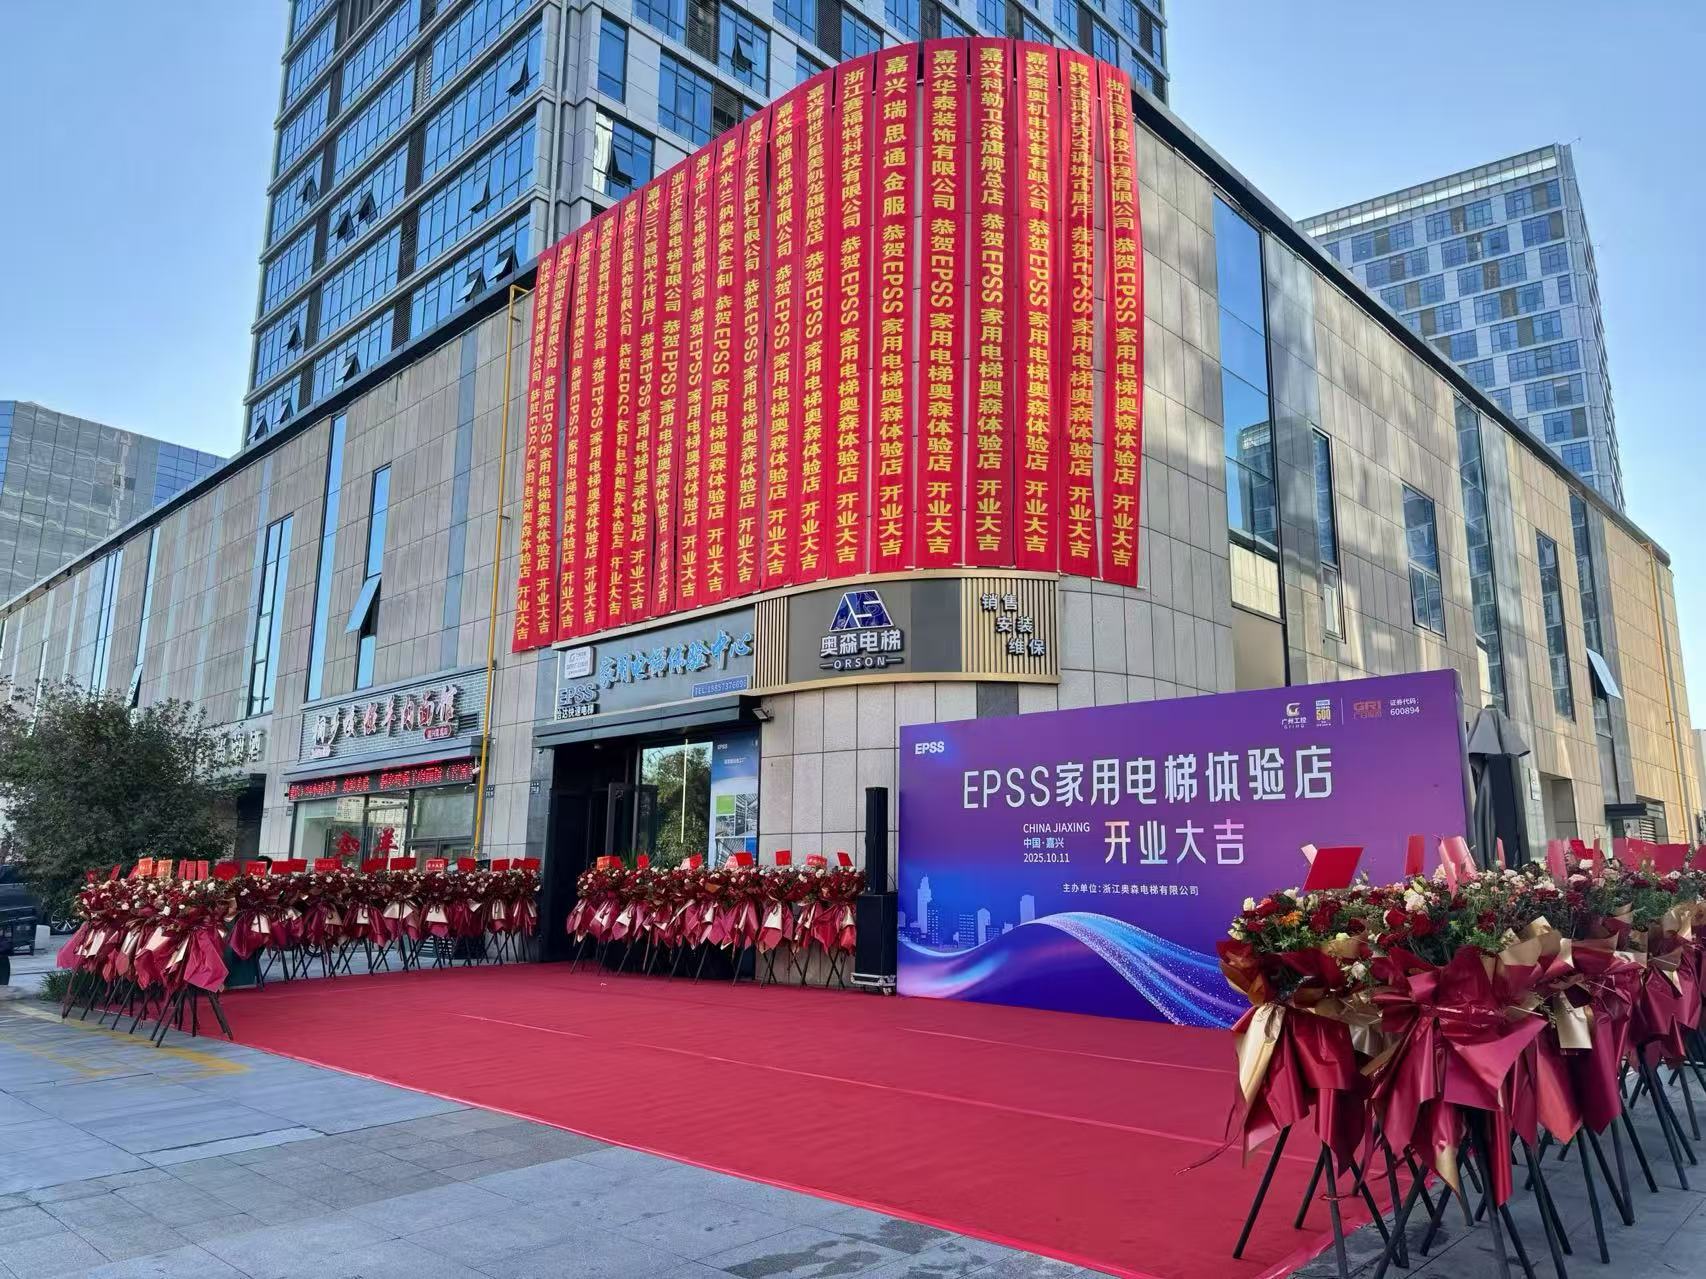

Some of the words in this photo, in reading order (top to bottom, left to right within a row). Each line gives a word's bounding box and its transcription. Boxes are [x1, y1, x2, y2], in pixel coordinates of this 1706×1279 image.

[841, 69, 864, 228] 浙江赛福特科技有限公司
[883, 56, 907, 216] 嘉兴瑞思通金服
[931, 49, 956, 211] 嘉兴华泰装饰有限公司
[980, 47, 1005, 205] 嘉兴科勒卫浴旗舰总店
[776, 101, 793, 257] 嘉兴畅通电梯有限公司
[692, 154, 709, 299] 海宁市广达电梯有限公司
[716, 139, 735, 287] 嘉兴米兰纳整家定制
[642, 186, 660, 328] 嘉兴三只喜鹊木作展厅
[767, 508, 786, 576] 开业大吉
[800, 501, 818, 570] 开业大吉
[837, 492, 857, 564] 开业大吉
[880, 485, 902, 556] 开业大吉
[927, 481, 952, 554] 开业大吉
[976, 479, 1000, 551] 开业大吉
[1025, 480, 1046, 553] 开业大吉
[1070, 486, 1090, 558] 开业大吉
[1113, 494, 1133, 566] 开业大吉
[631, 549, 644, 609] 开业大吉
[657, 542, 670, 604] 开业大吉
[681, 534, 697, 597] 开业大吉
[707, 527, 723, 592] 开业大吉
[738, 517, 753, 583] 开业大吉
[516, 585, 529, 640] 开业大吉
[537, 577, 548, 634] 开业大吉
[561, 571, 574, 628] 开业大吉
[584, 565, 596, 624] 开业大吉
[609, 556, 622, 615] 开业大吉
[981, 592, 1018, 610] 销售
[820, 629, 901, 657] 奥森电梯
[996, 615, 1034, 633] 安装
[1008, 638, 1045, 655] 维保
[558, 681, 595, 707] EPSS
[833, 657, 886, 669] ORSON
[1281, 716, 1307, 726] 广州工控
[1315, 708, 1332, 721] 500
[1389, 706, 1420, 716] 600894
[914, 741, 945, 755] EPSS
[962, 744, 1334, 809] EPSS家用电梯体验店
[1022, 822, 1051, 833] CHINA
[1054, 821, 1090, 833] JIAXING
[1023, 852, 1070, 864] 2025.10.11
[1104, 818, 1245, 866] 开业大吉
